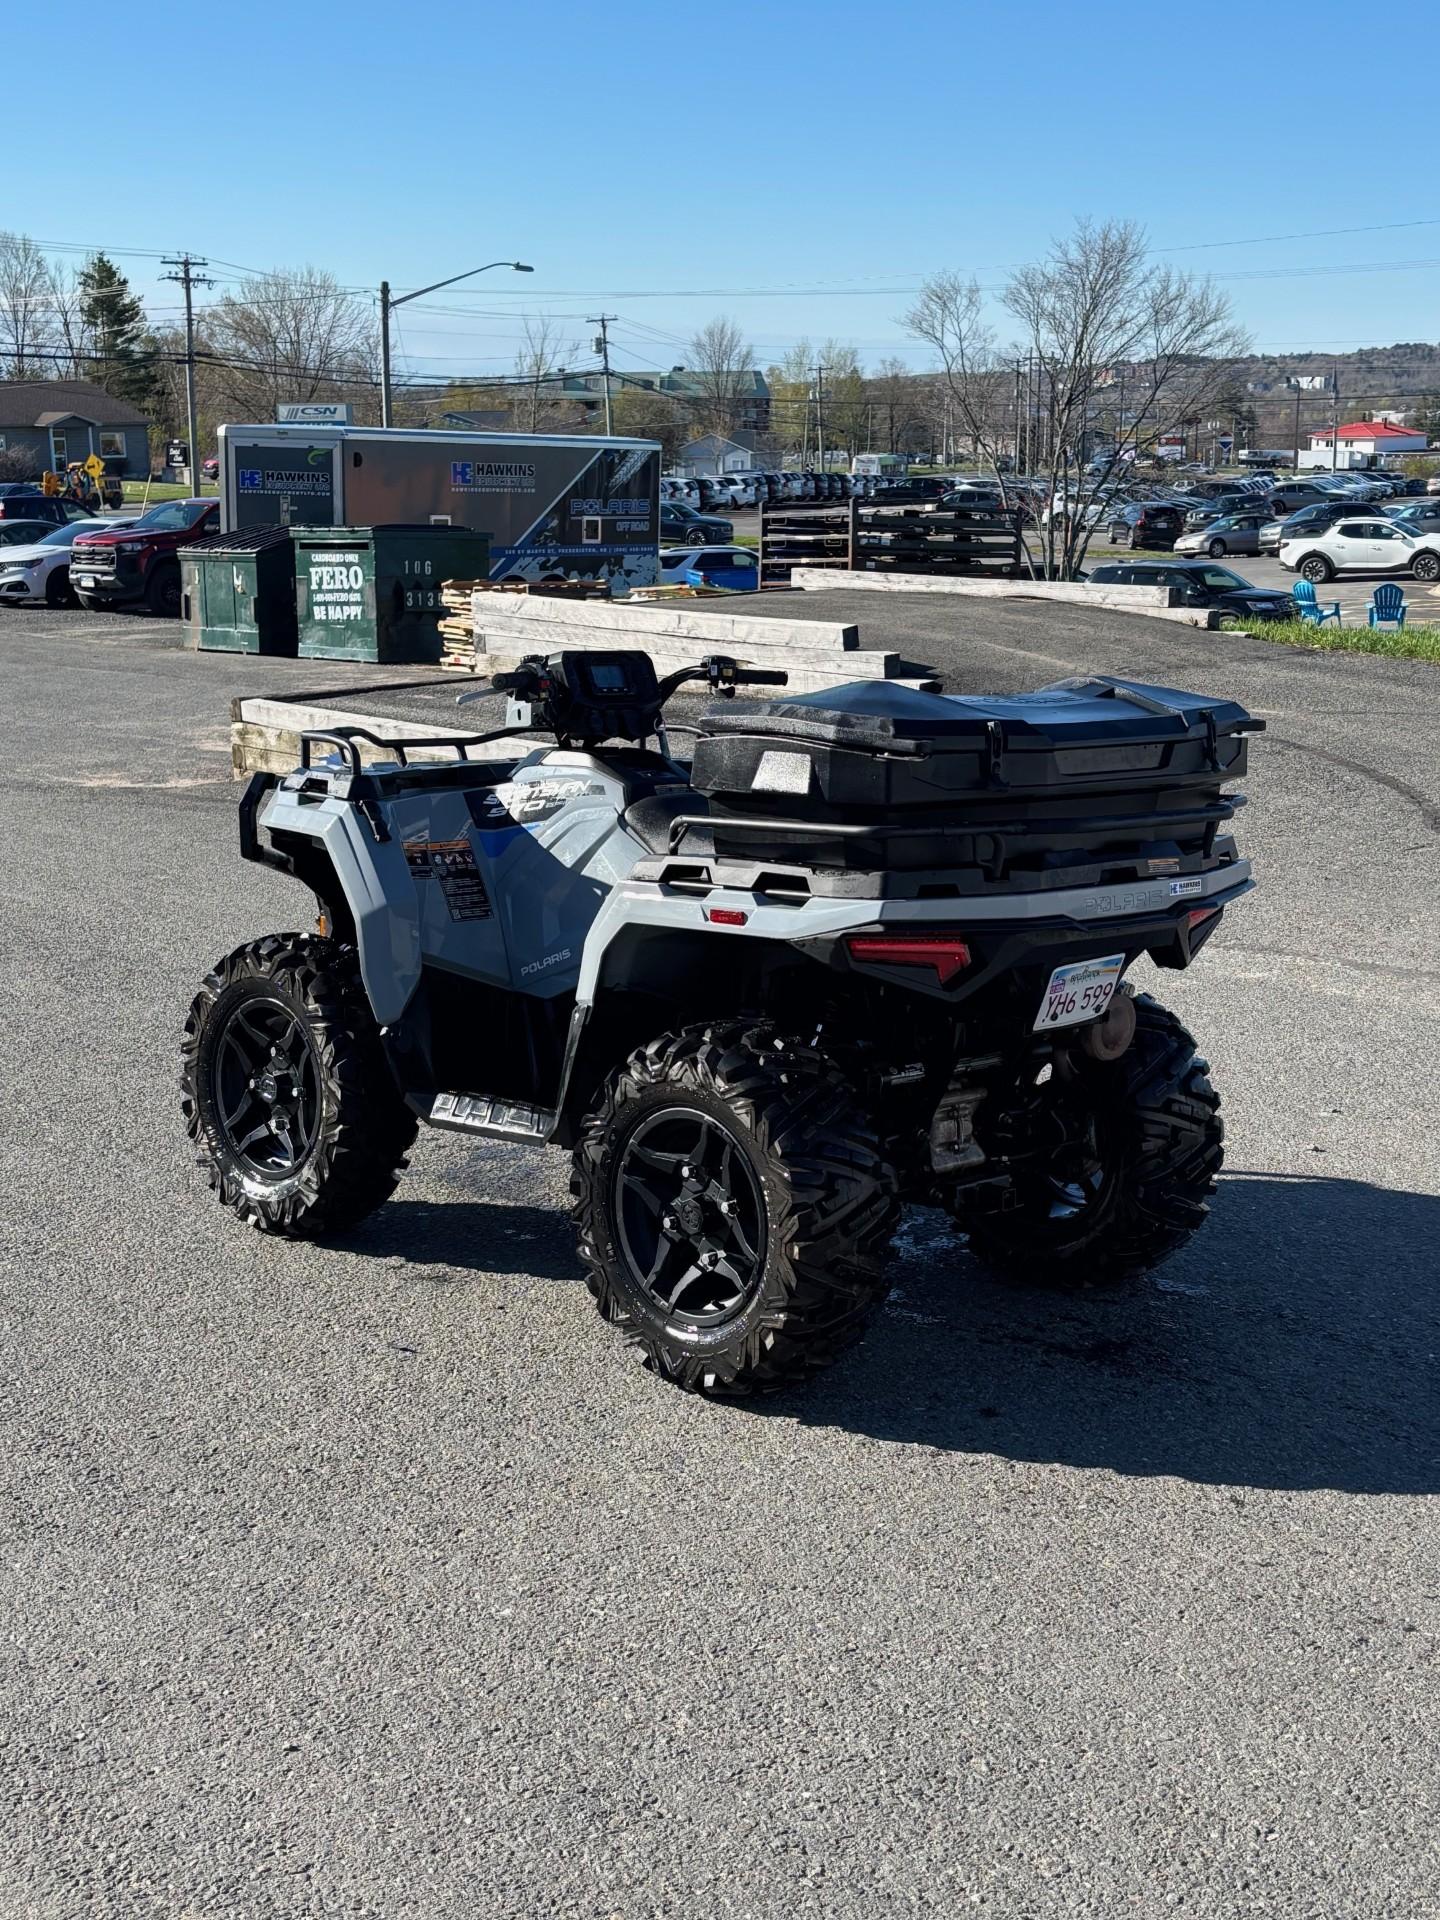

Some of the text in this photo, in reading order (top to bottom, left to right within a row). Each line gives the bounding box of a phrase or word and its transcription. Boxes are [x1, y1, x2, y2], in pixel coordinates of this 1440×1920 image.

[301, 407, 338, 416] CSN
[265, 471, 330, 484] HAWKINS
[476, 463, 536, 478] HAWKINS
[571, 499, 651, 515] POLARIS
[310, 567, 364, 590] FERO
[314, 606, 363, 620] BE HAPPY
[1084, 890, 1164, 914] POLARIS
[521, 949, 571, 977] POLARIS
[1047, 992, 1077, 1018] YH6
[1082, 983, 1113, 1010] 599
